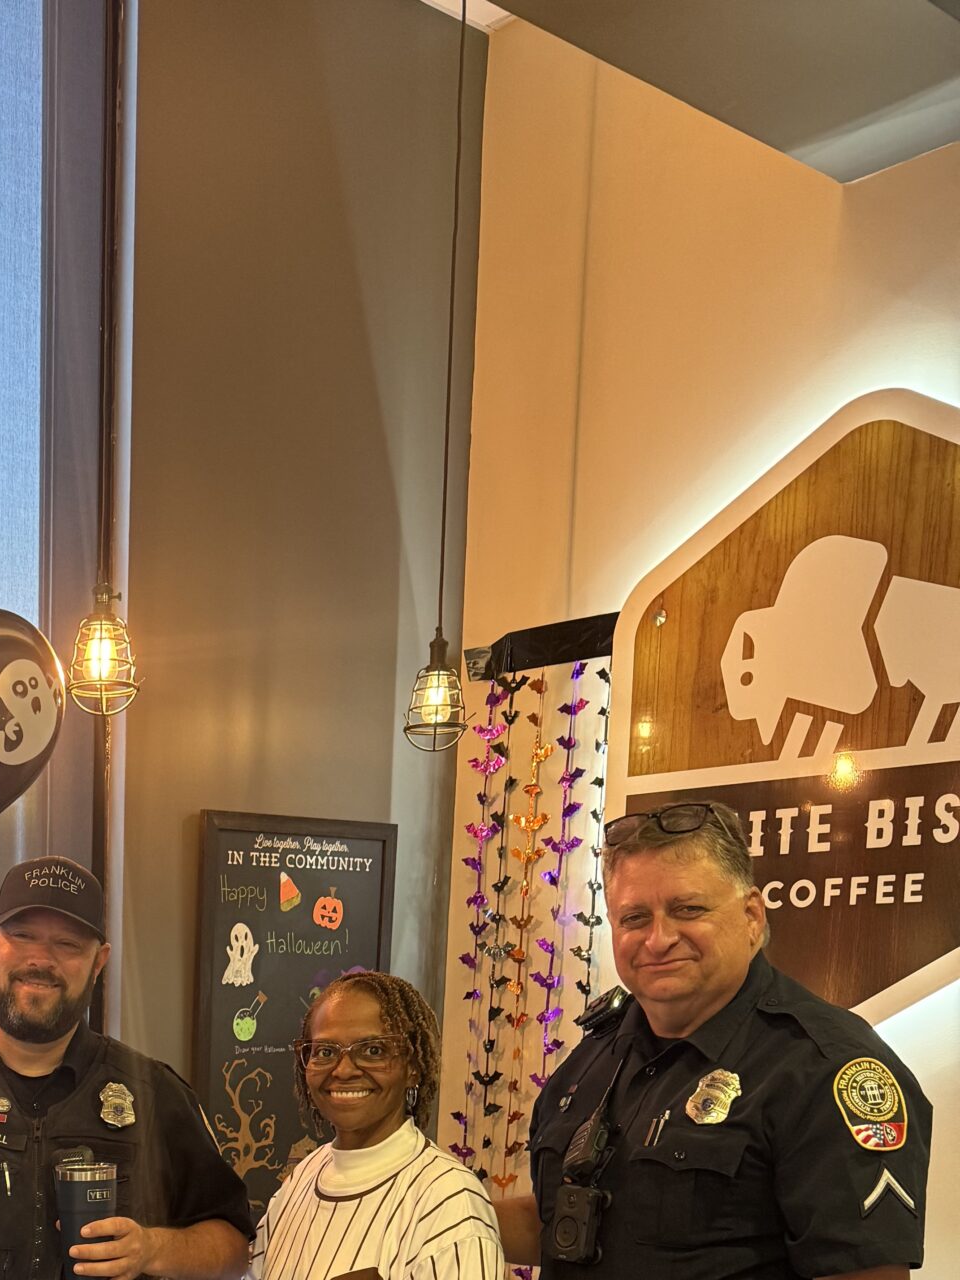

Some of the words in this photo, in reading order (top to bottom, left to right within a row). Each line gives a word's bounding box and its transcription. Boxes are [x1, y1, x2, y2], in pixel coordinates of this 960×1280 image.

[747, 804, 833, 857] ITE
[864, 793, 960, 849] BIS
[254, 833, 272, 849] Live
[303, 836, 321, 855] Play
[227, 850, 243, 865] IN
[250, 852, 280, 867] THE
[286, 854, 373, 872] COMMUNITY
[24, 865, 86, 890] FRANKLIN
[29, 877, 79, 895] POLICE
[762, 872, 925, 910] COFFEE
[220, 874, 267, 912] Happy
[265, 928, 349, 956] Halloween!
[838, 1061, 870, 1089] FRANKLIN
[870, 1063, 893, 1084] POLICE
